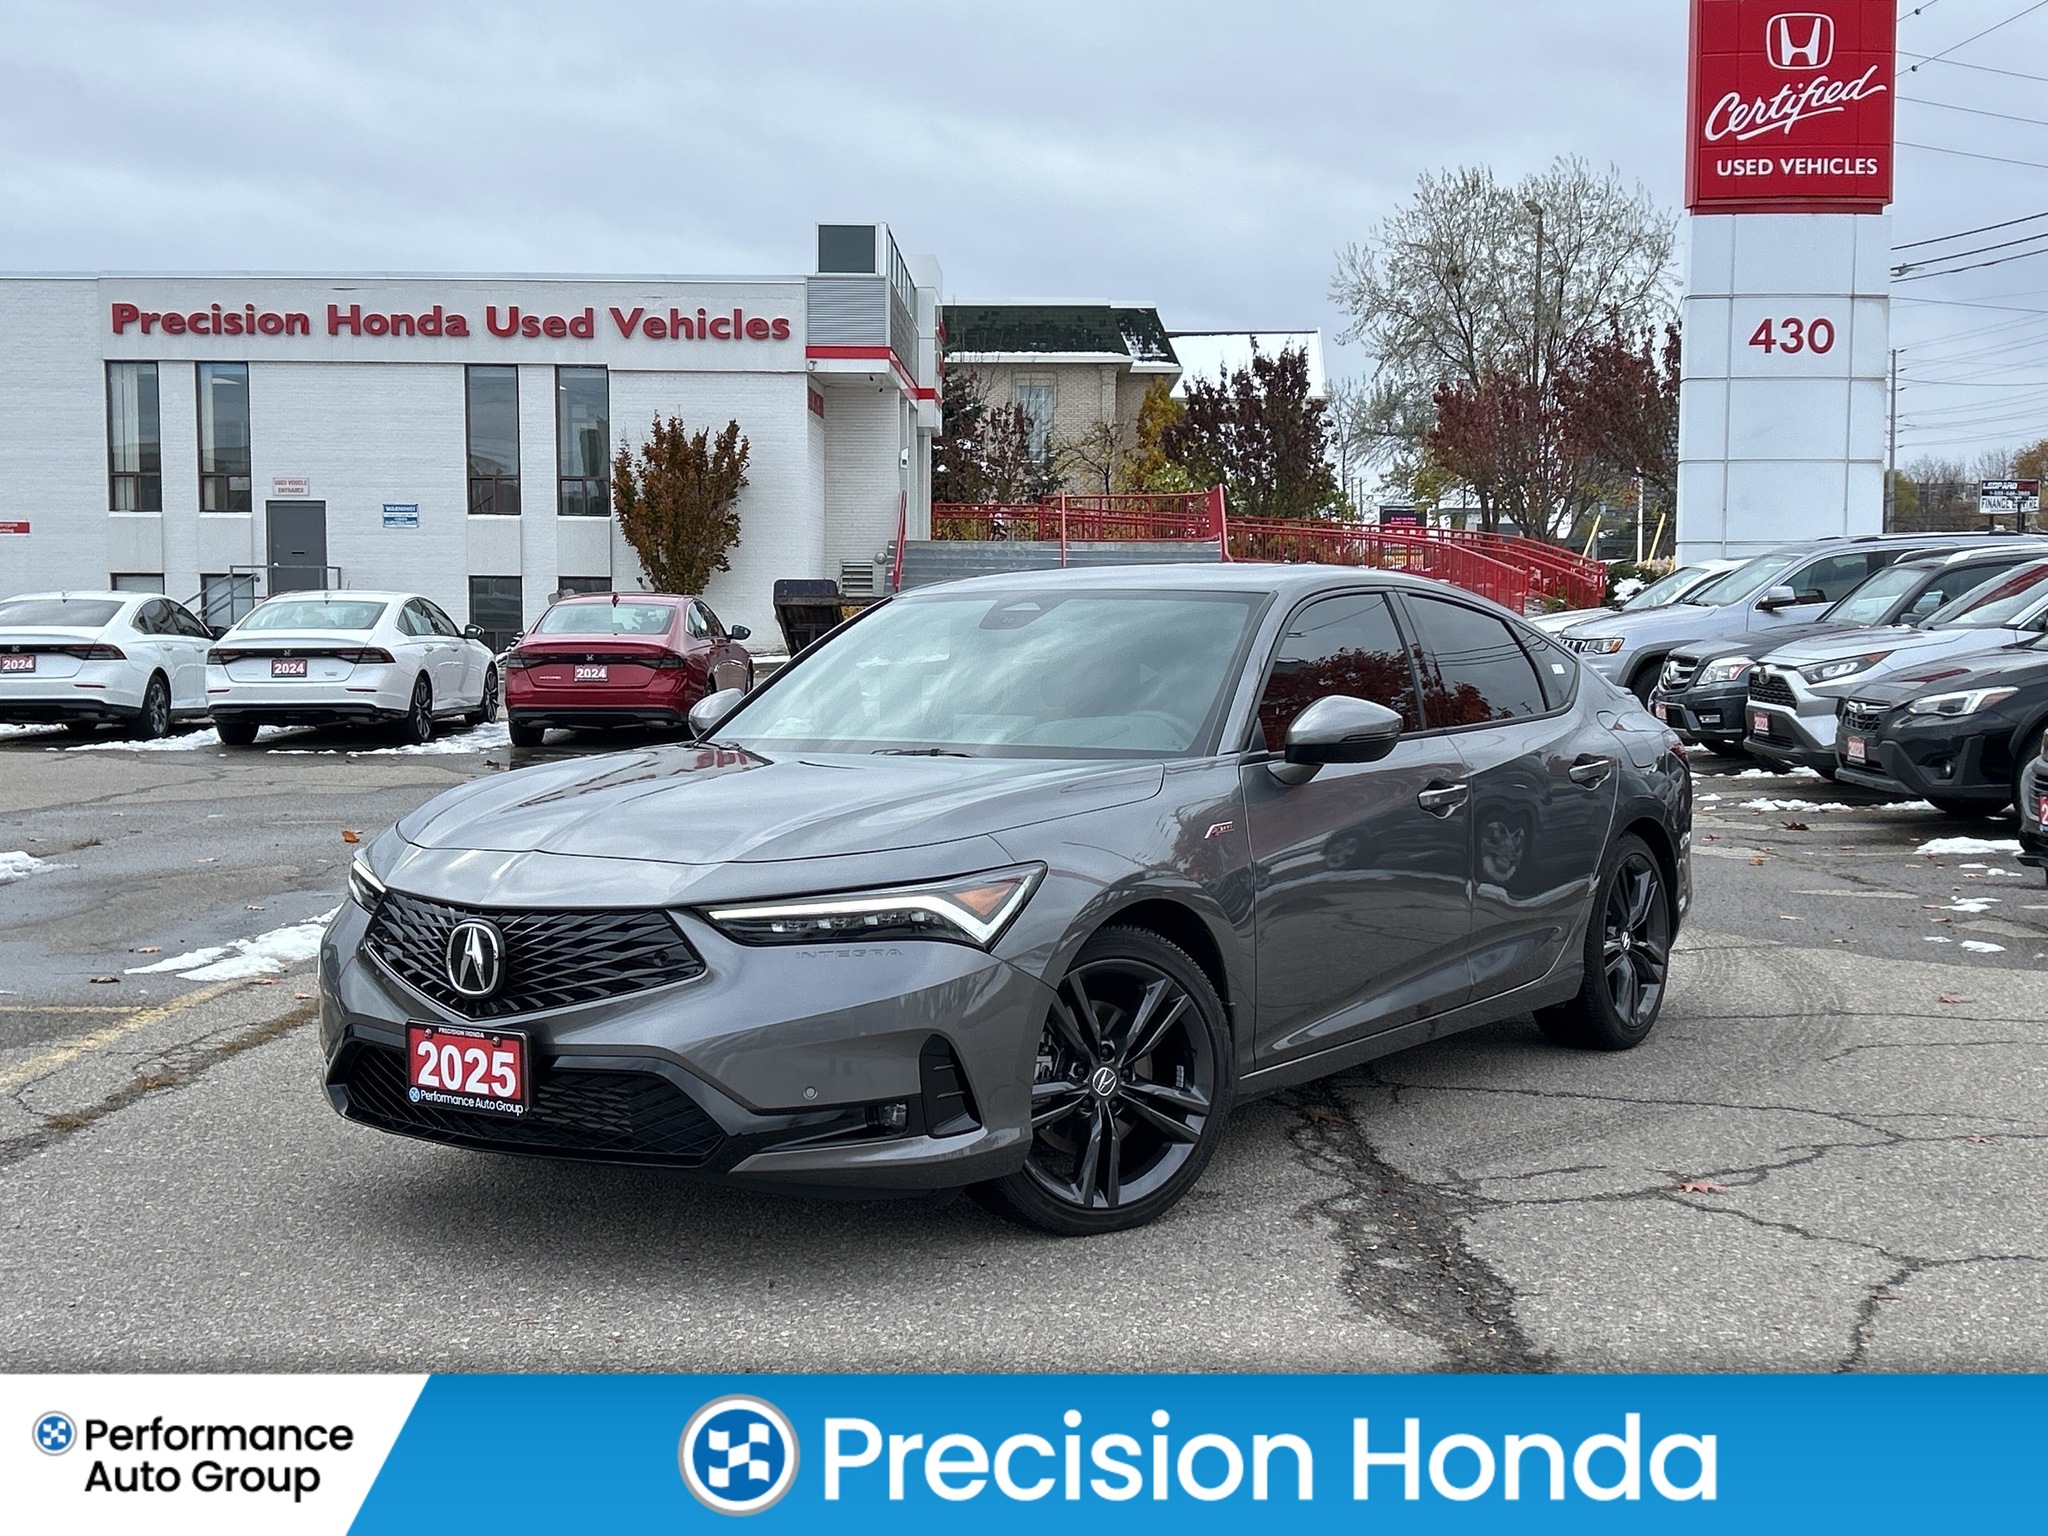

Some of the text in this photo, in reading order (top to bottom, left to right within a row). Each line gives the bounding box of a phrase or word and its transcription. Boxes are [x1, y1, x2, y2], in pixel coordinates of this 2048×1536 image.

[1705, 65, 1887, 141] Certified
[1717, 157, 1878, 176] USED VEHICLES
[111, 303, 790, 340] Precision Honda Used Vehicles
[1749, 317, 1835, 354] 430
[2, 659, 34, 670] 2024
[274, 663, 305, 674] 2024
[576, 668, 607, 679] 2024
[795, 948, 903, 959] INTEGRA
[438, 1027, 464, 1036] PRECISION
[417, 1040, 516, 1098] 2025
[420, 1089, 524, 1117] Performance Auto Group
